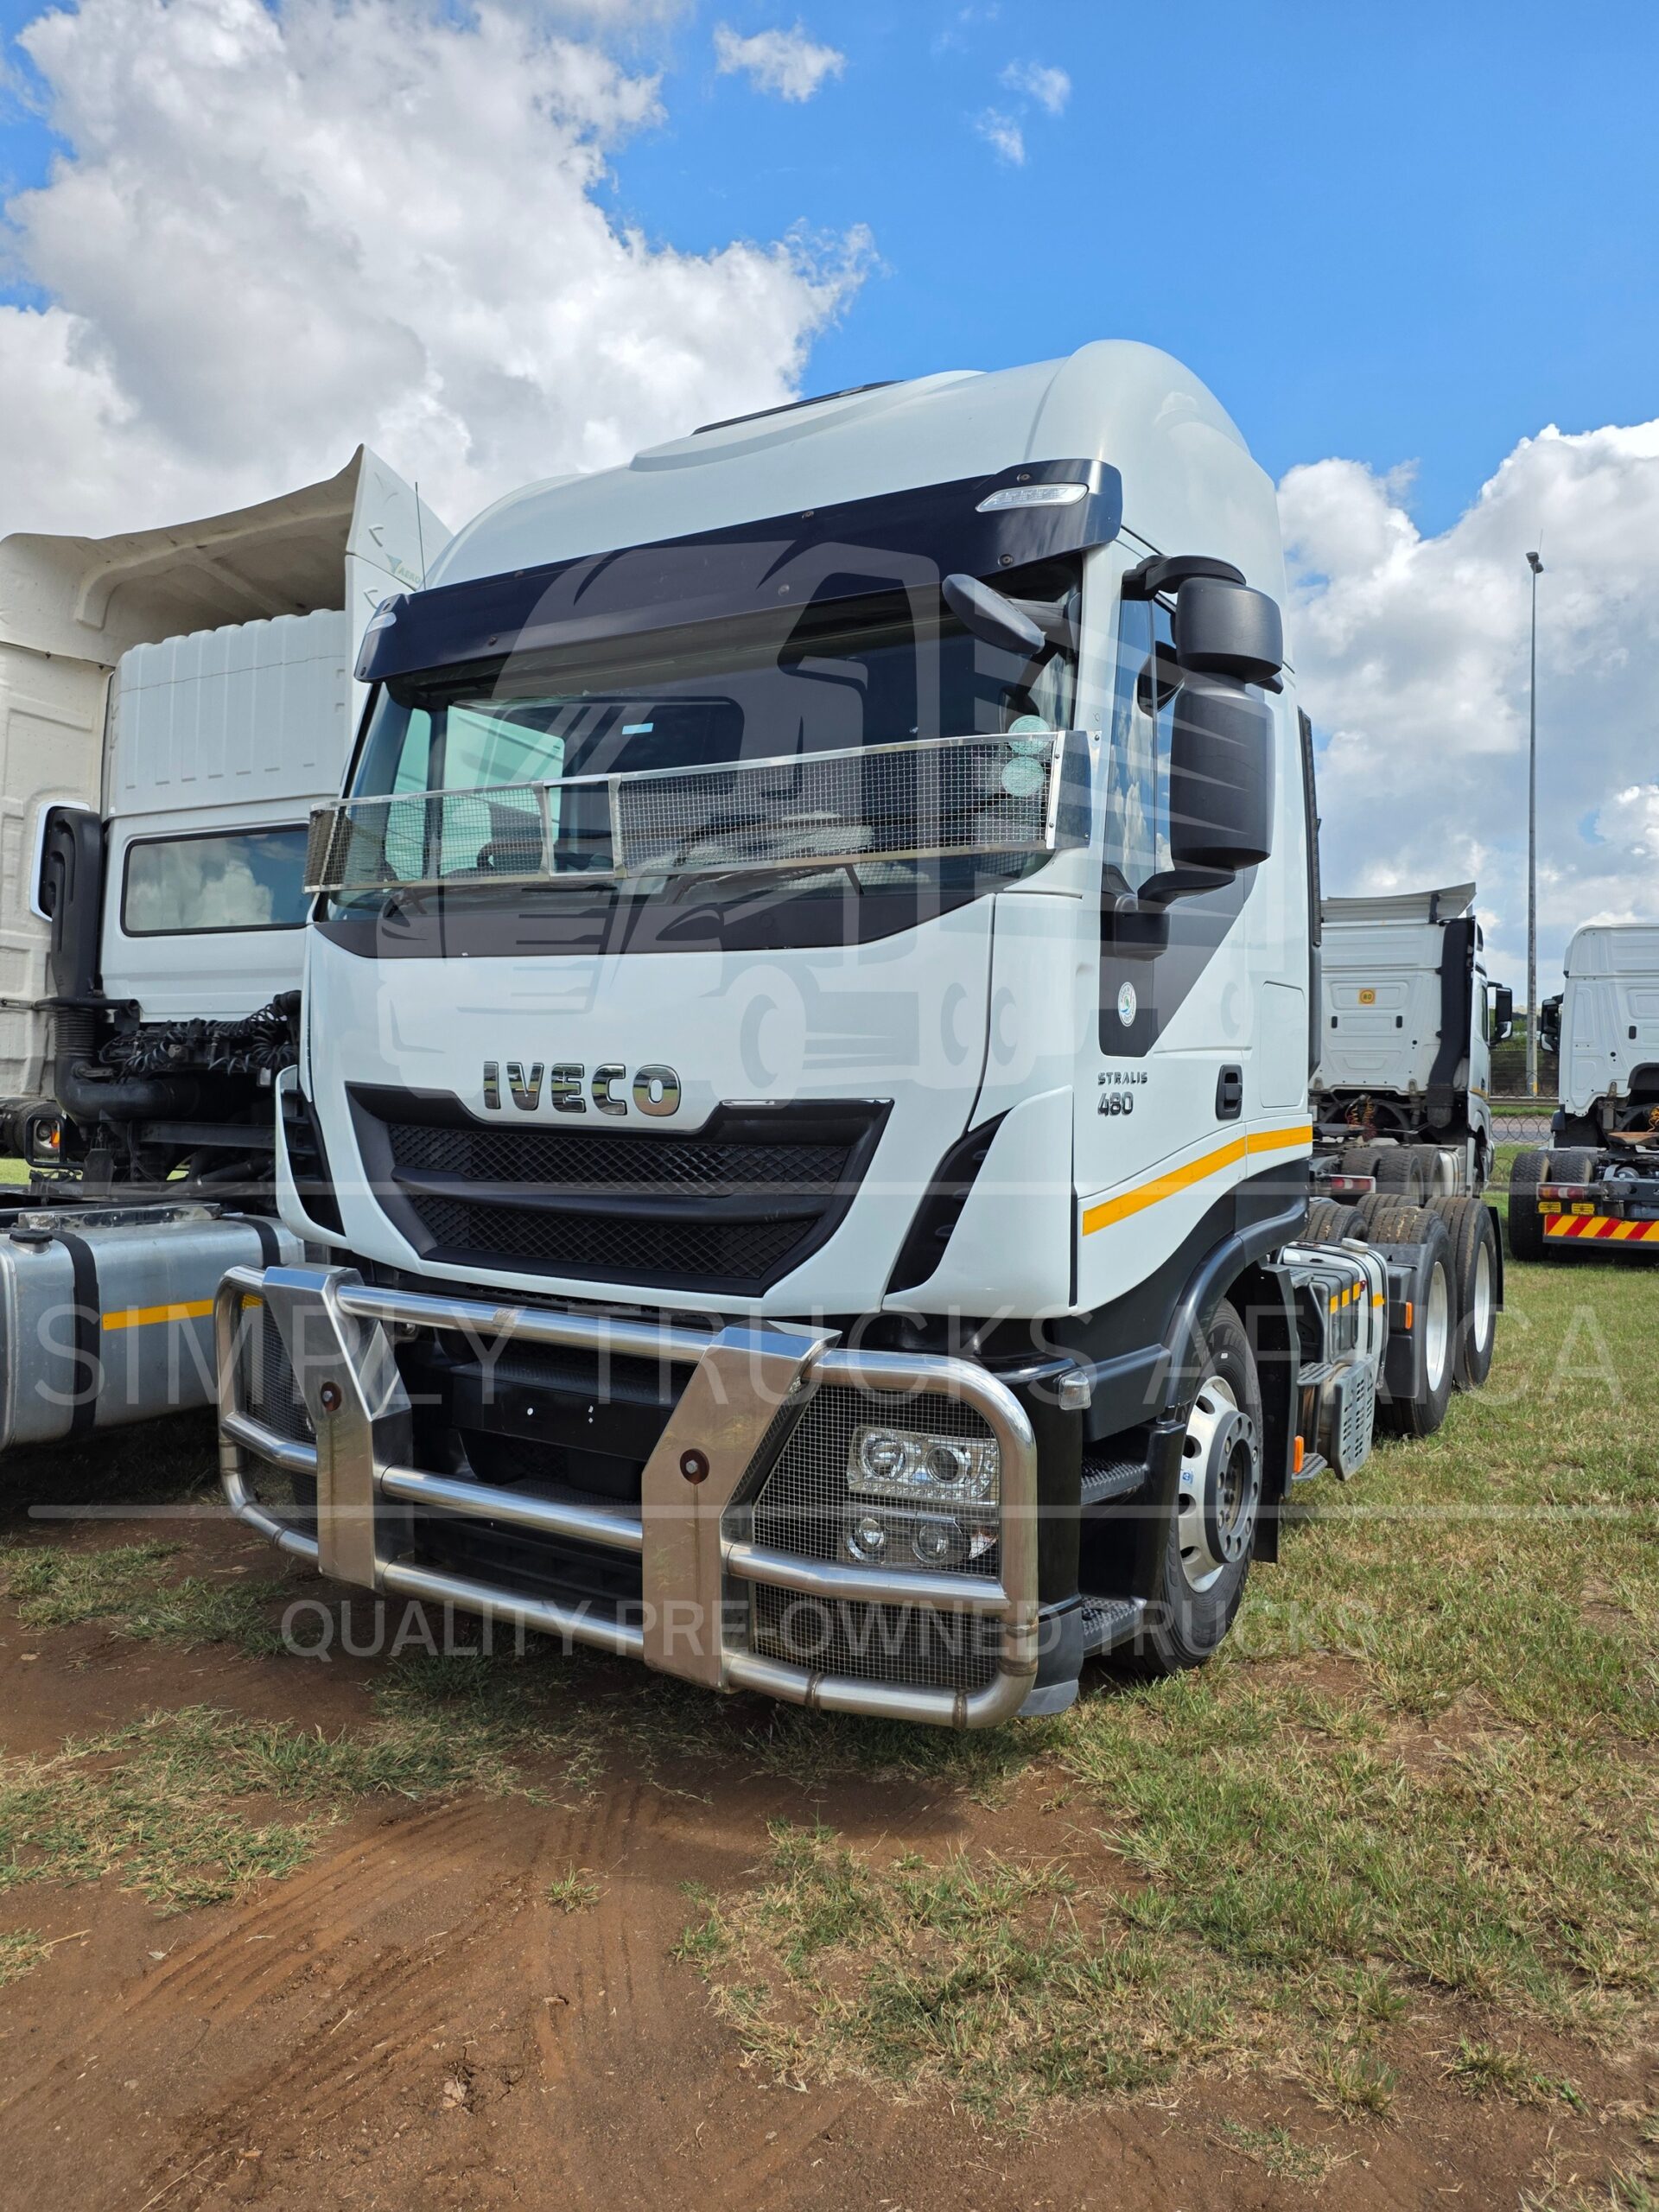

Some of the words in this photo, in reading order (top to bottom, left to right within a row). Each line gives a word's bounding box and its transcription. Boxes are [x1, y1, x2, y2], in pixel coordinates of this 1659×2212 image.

[483, 1061, 682, 1117] IVECO
[1097, 1071, 1148, 1085] STRALIS
[1097, 1091, 1134, 1116] 480
